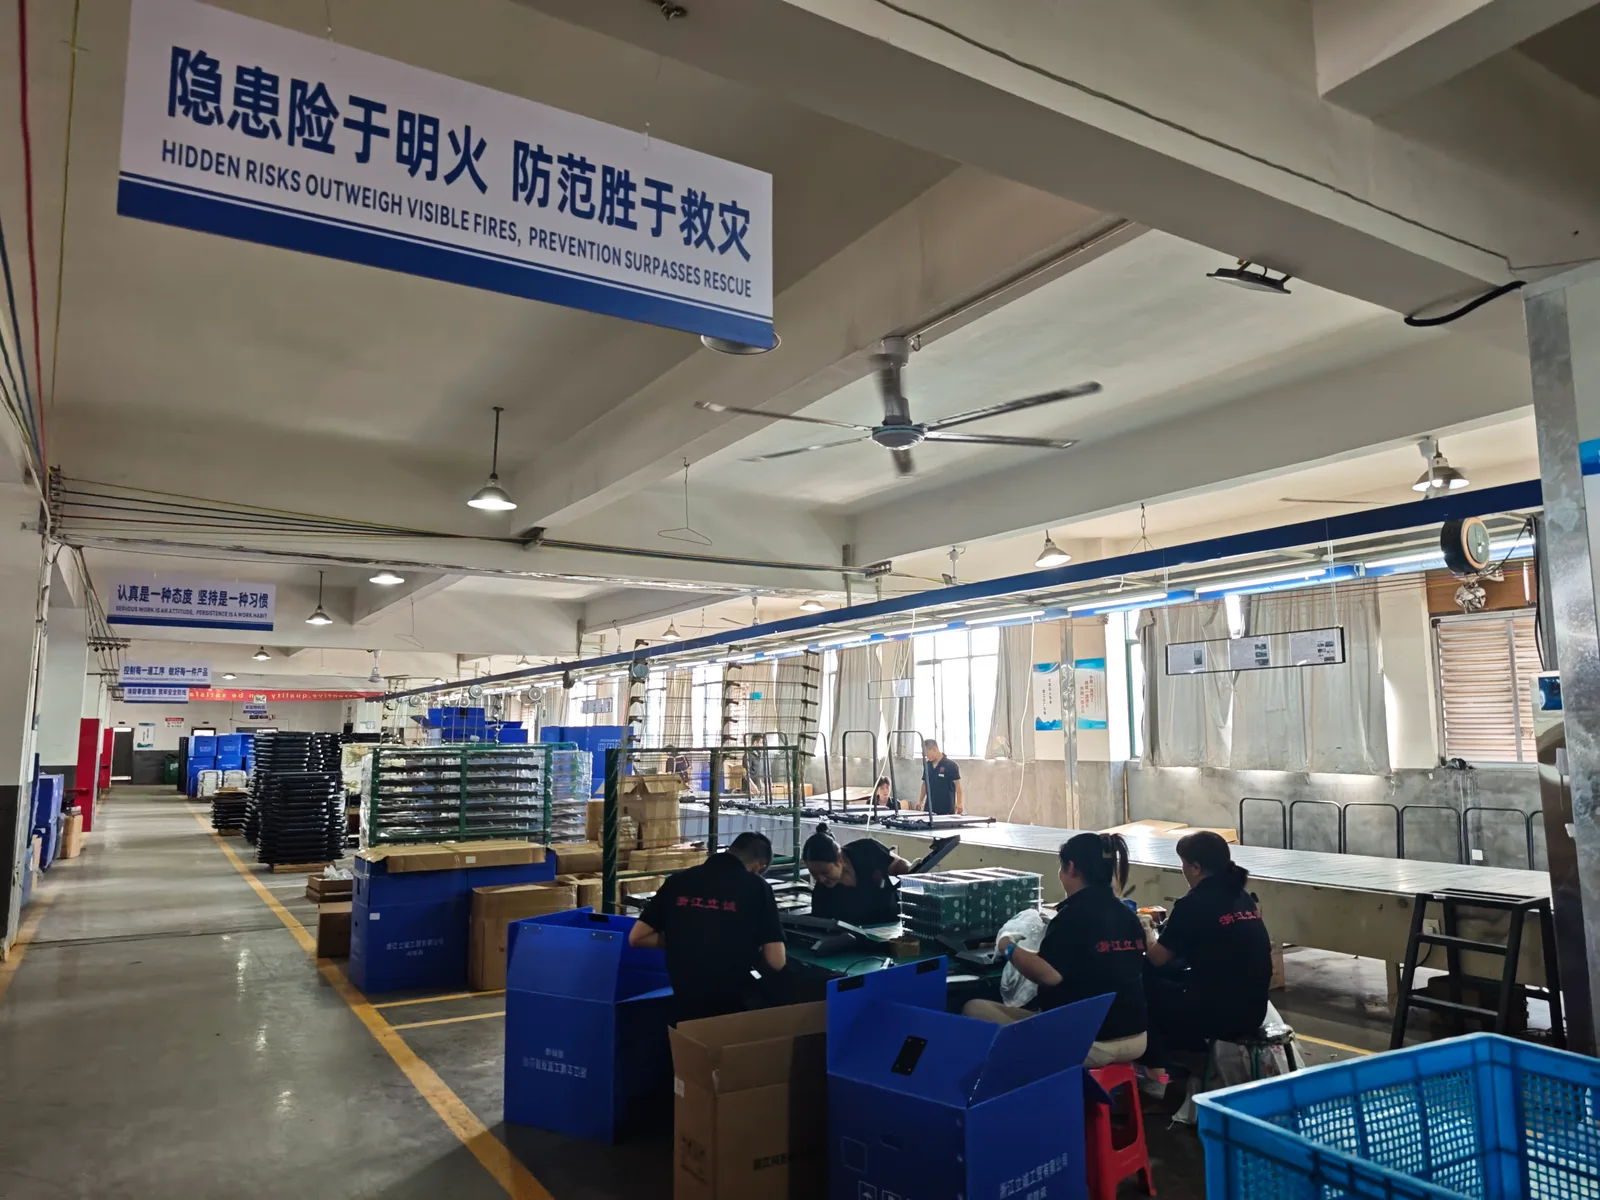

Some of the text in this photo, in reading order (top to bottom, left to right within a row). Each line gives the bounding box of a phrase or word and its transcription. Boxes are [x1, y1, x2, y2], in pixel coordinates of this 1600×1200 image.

[161, 139, 751, 298] HIDDEN RISKS OUTWEIGH VISIBLE FIRES, PREVENTION SURPASSES RESCUE
[167, 45, 751, 262] 隐患险于明火 防范胜于救灾
[117, 584, 268, 609] 认真是一种态度 坚持是一种习惯
